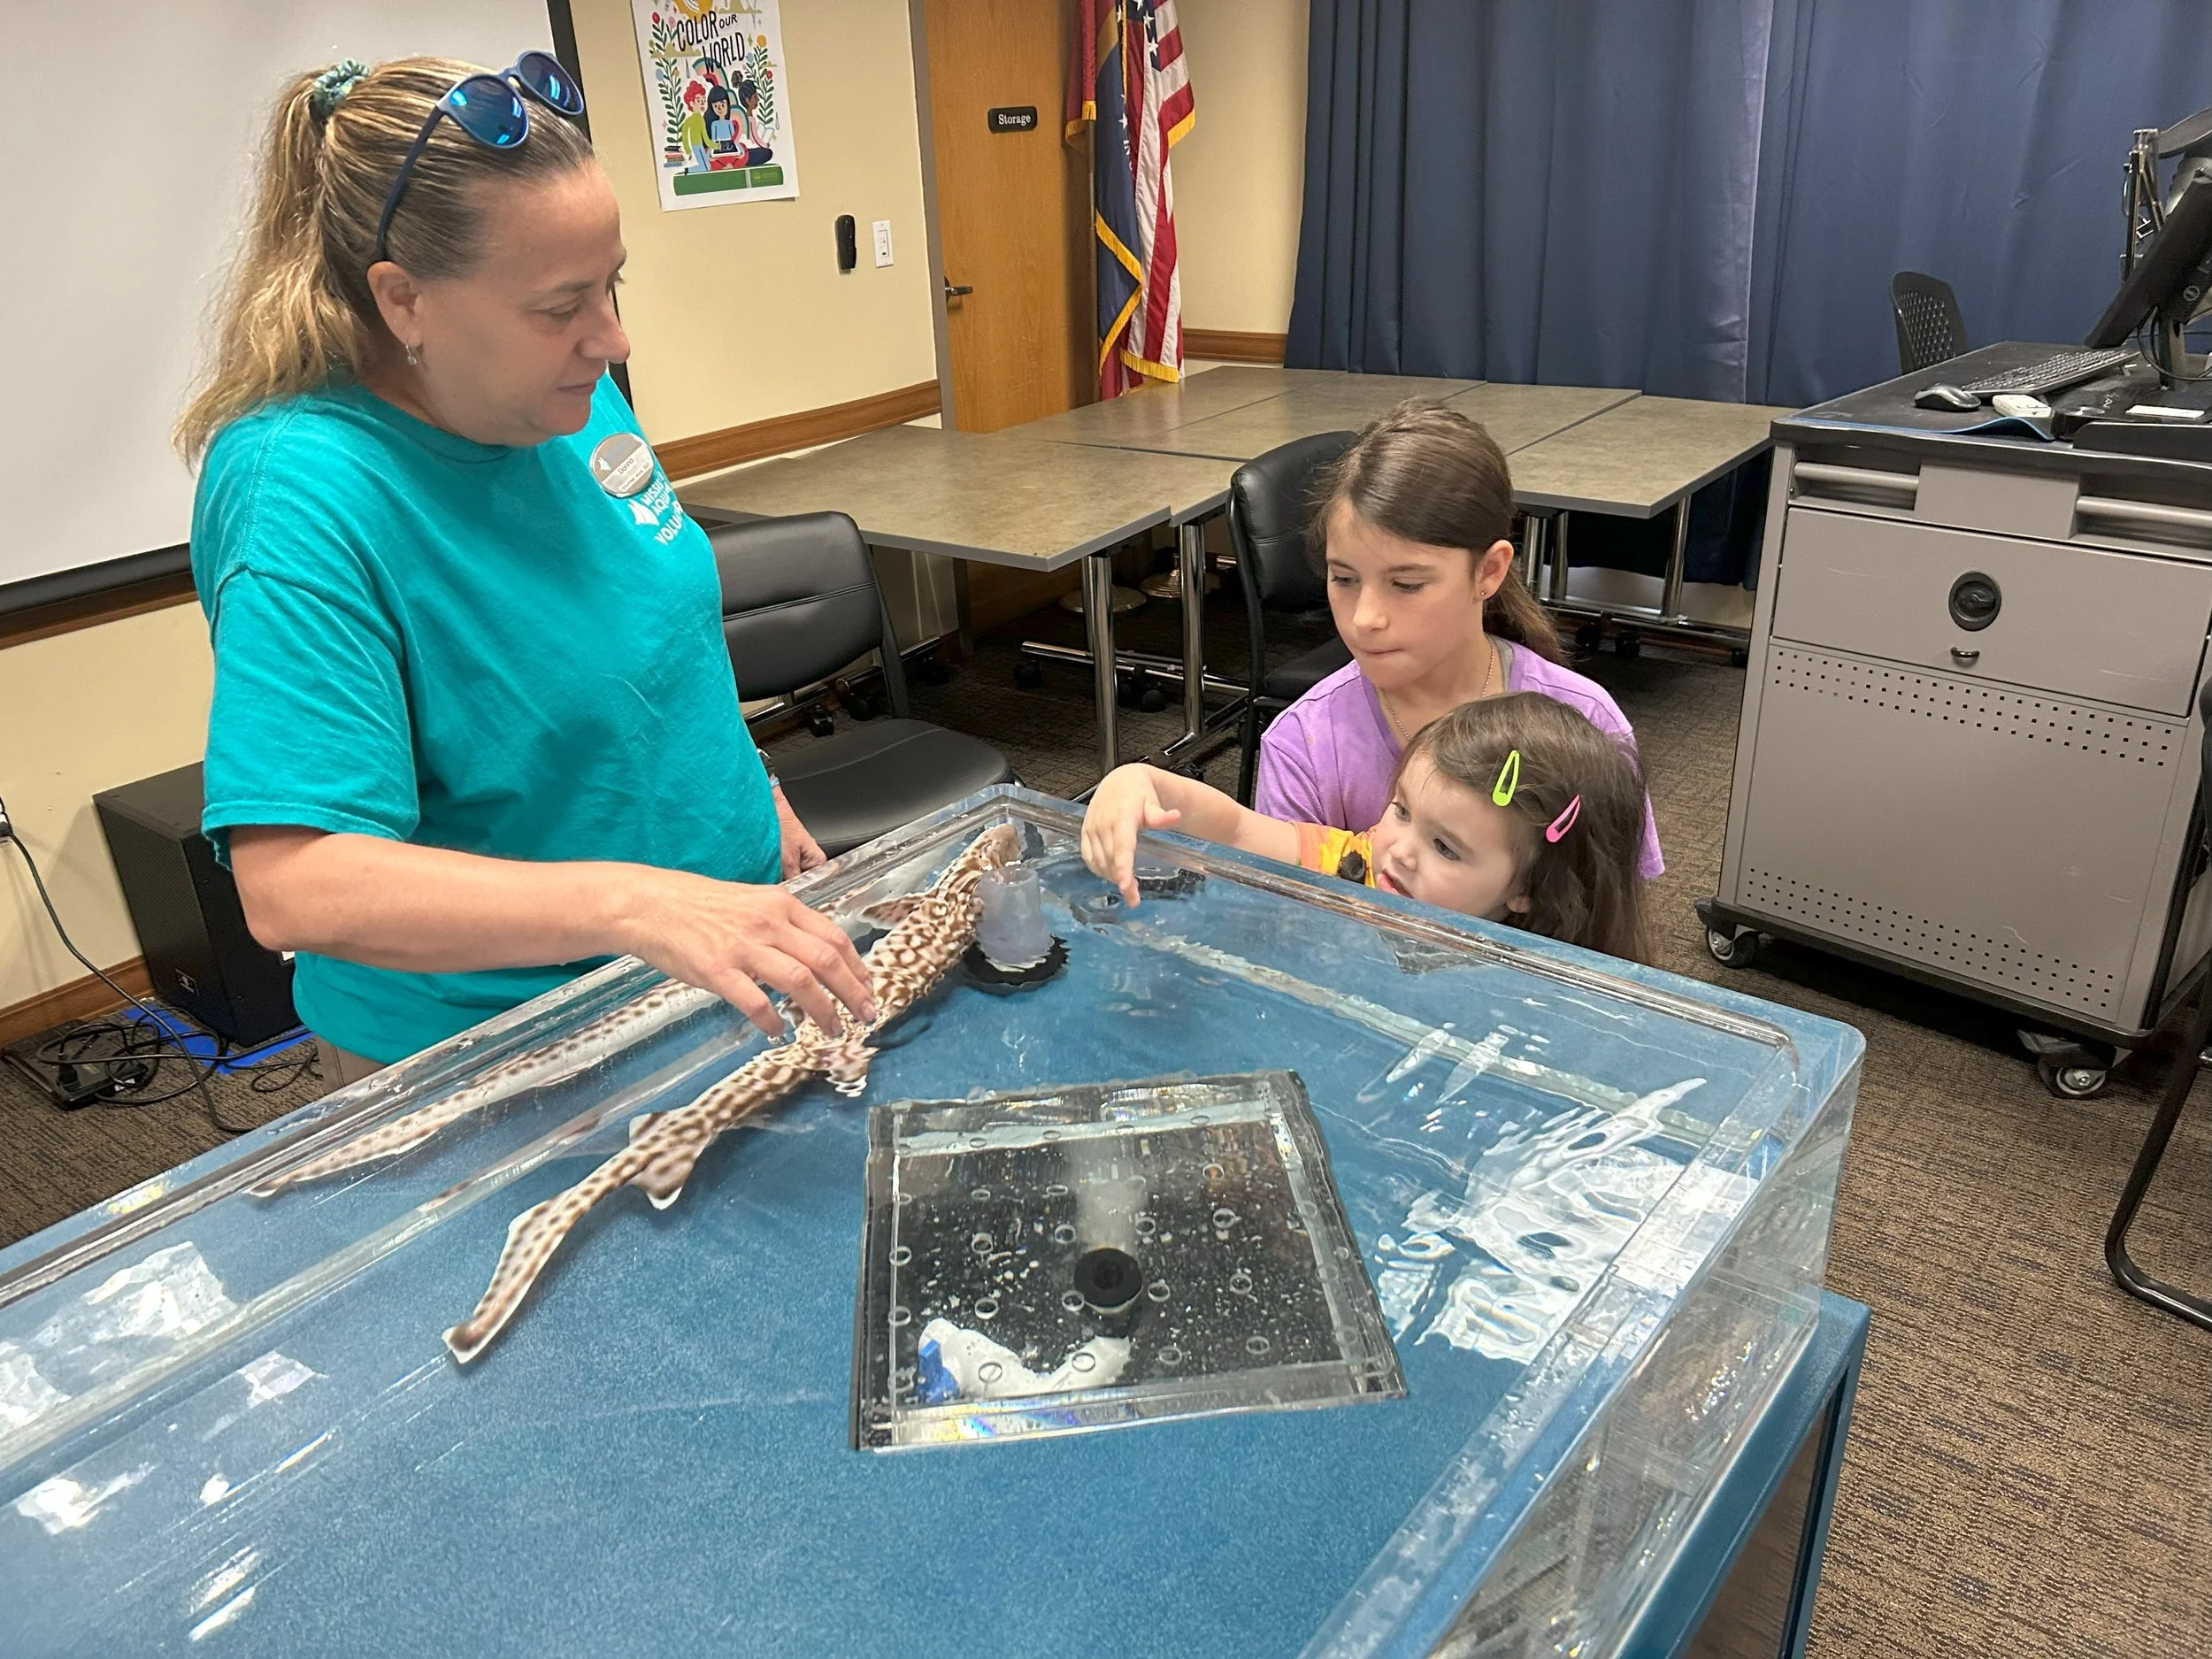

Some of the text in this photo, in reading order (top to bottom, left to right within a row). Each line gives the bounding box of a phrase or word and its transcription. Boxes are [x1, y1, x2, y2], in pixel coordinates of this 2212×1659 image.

[676, 11, 738, 51] COLOR OUR
[702, 32, 746, 73] WORLD
[998, 113, 1031, 127] Storage
